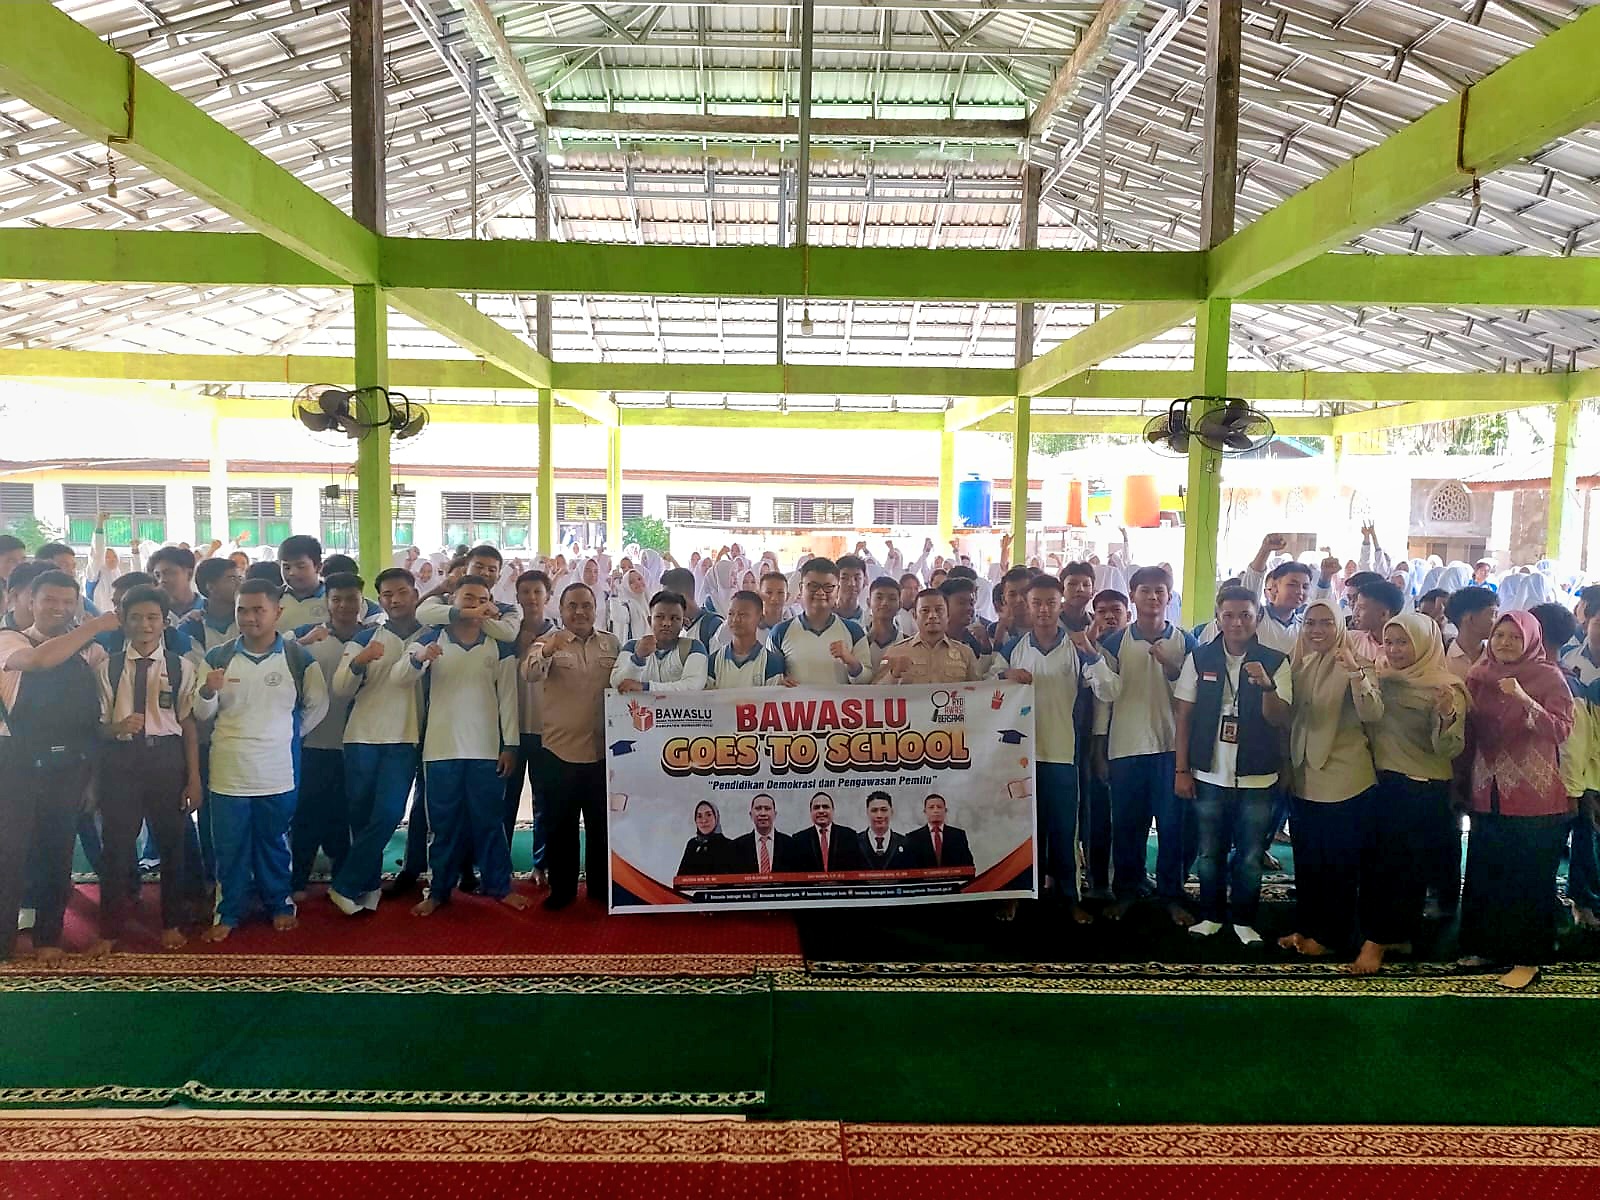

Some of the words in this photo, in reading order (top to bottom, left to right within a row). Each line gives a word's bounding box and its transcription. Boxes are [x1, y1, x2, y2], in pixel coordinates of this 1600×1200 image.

[655, 708, 712, 719] BAWASLU
[735, 698, 910, 732] BAWASLU
[661, 736, 760, 776] GOES
[766, 735, 819, 775] TO
[825, 729, 971, 773] SCHOOL
[767, 779, 816, 790] Demokrasi
[819, 779, 835, 789] dan
[838, 776, 897, 788] Pengawasan
